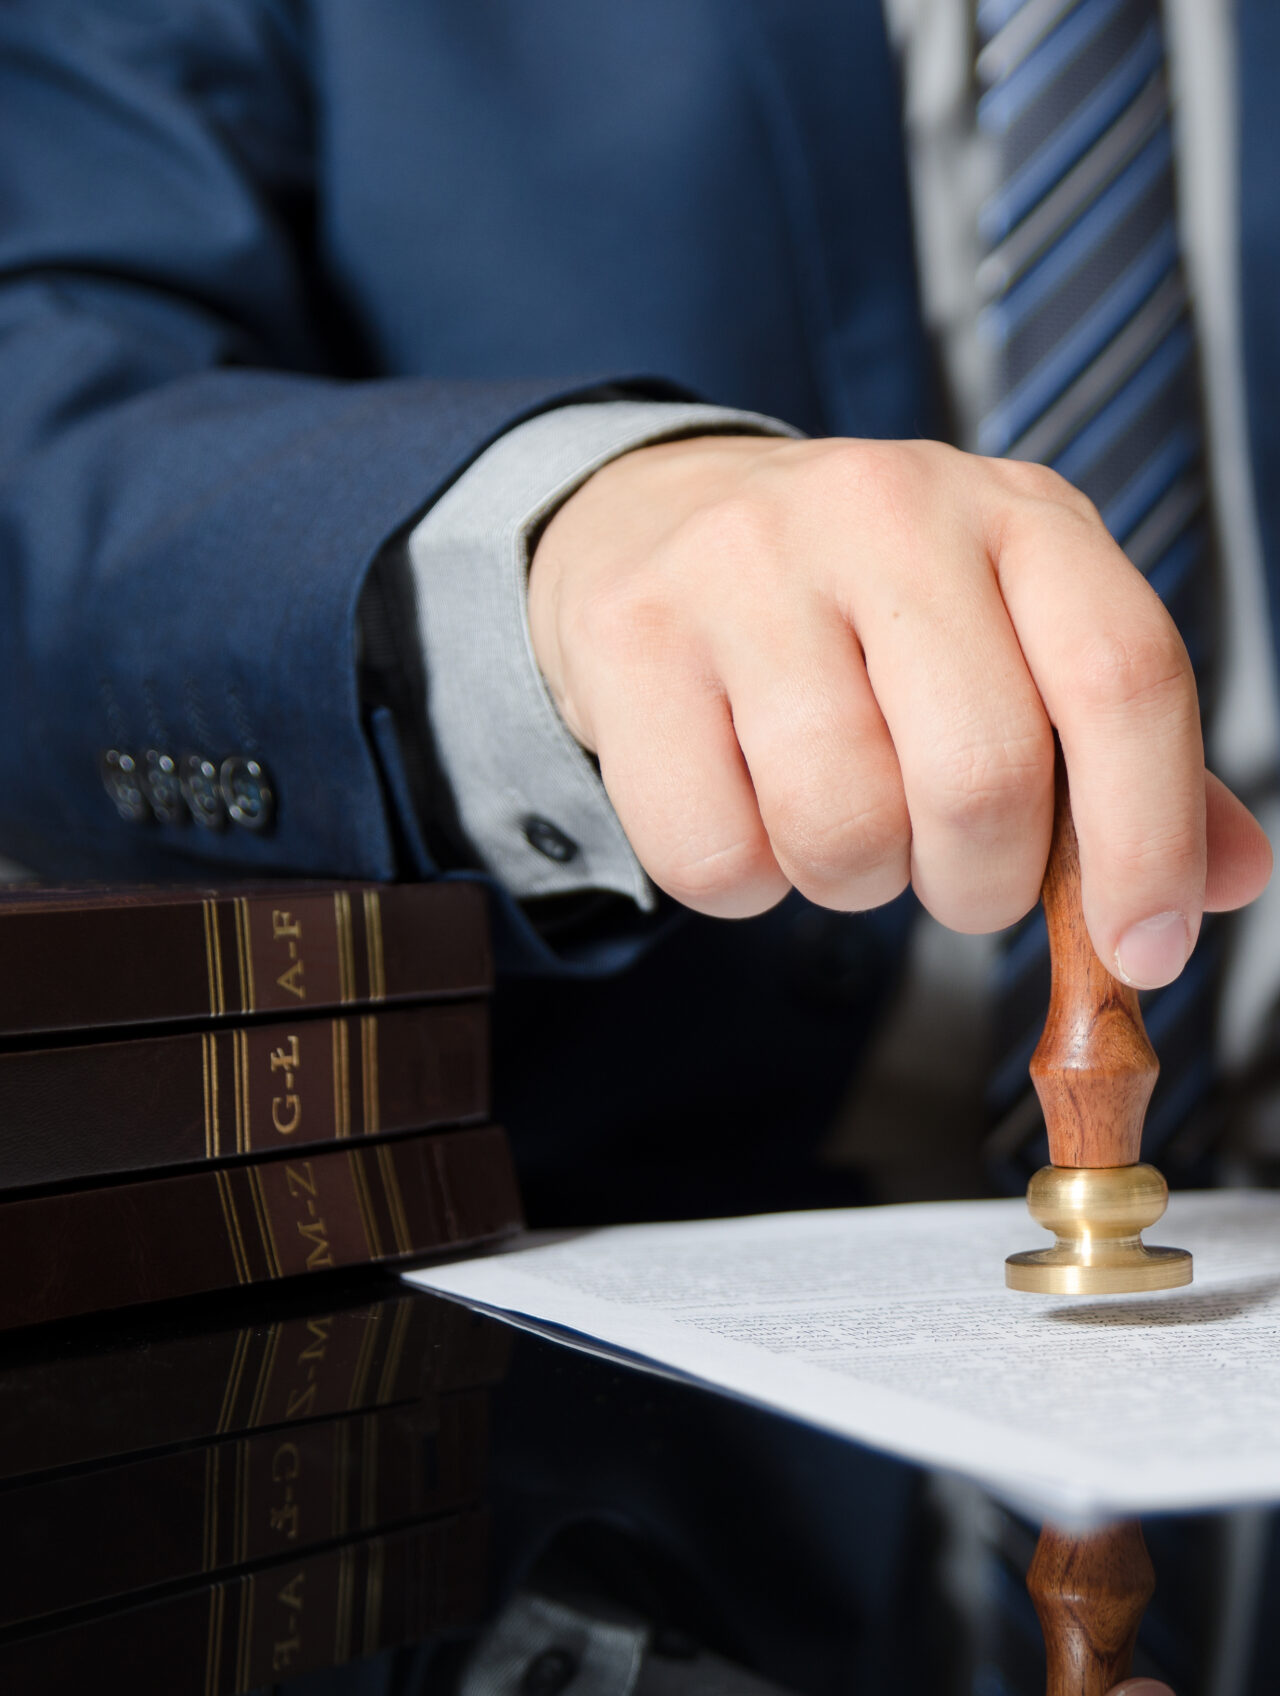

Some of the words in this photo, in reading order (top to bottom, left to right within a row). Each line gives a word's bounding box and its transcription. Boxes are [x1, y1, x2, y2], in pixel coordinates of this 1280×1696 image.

[272, 909, 306, 999] A-F
[270, 1035, 301, 1136] G-Ł
[284, 1160, 335, 1271] M-Z
